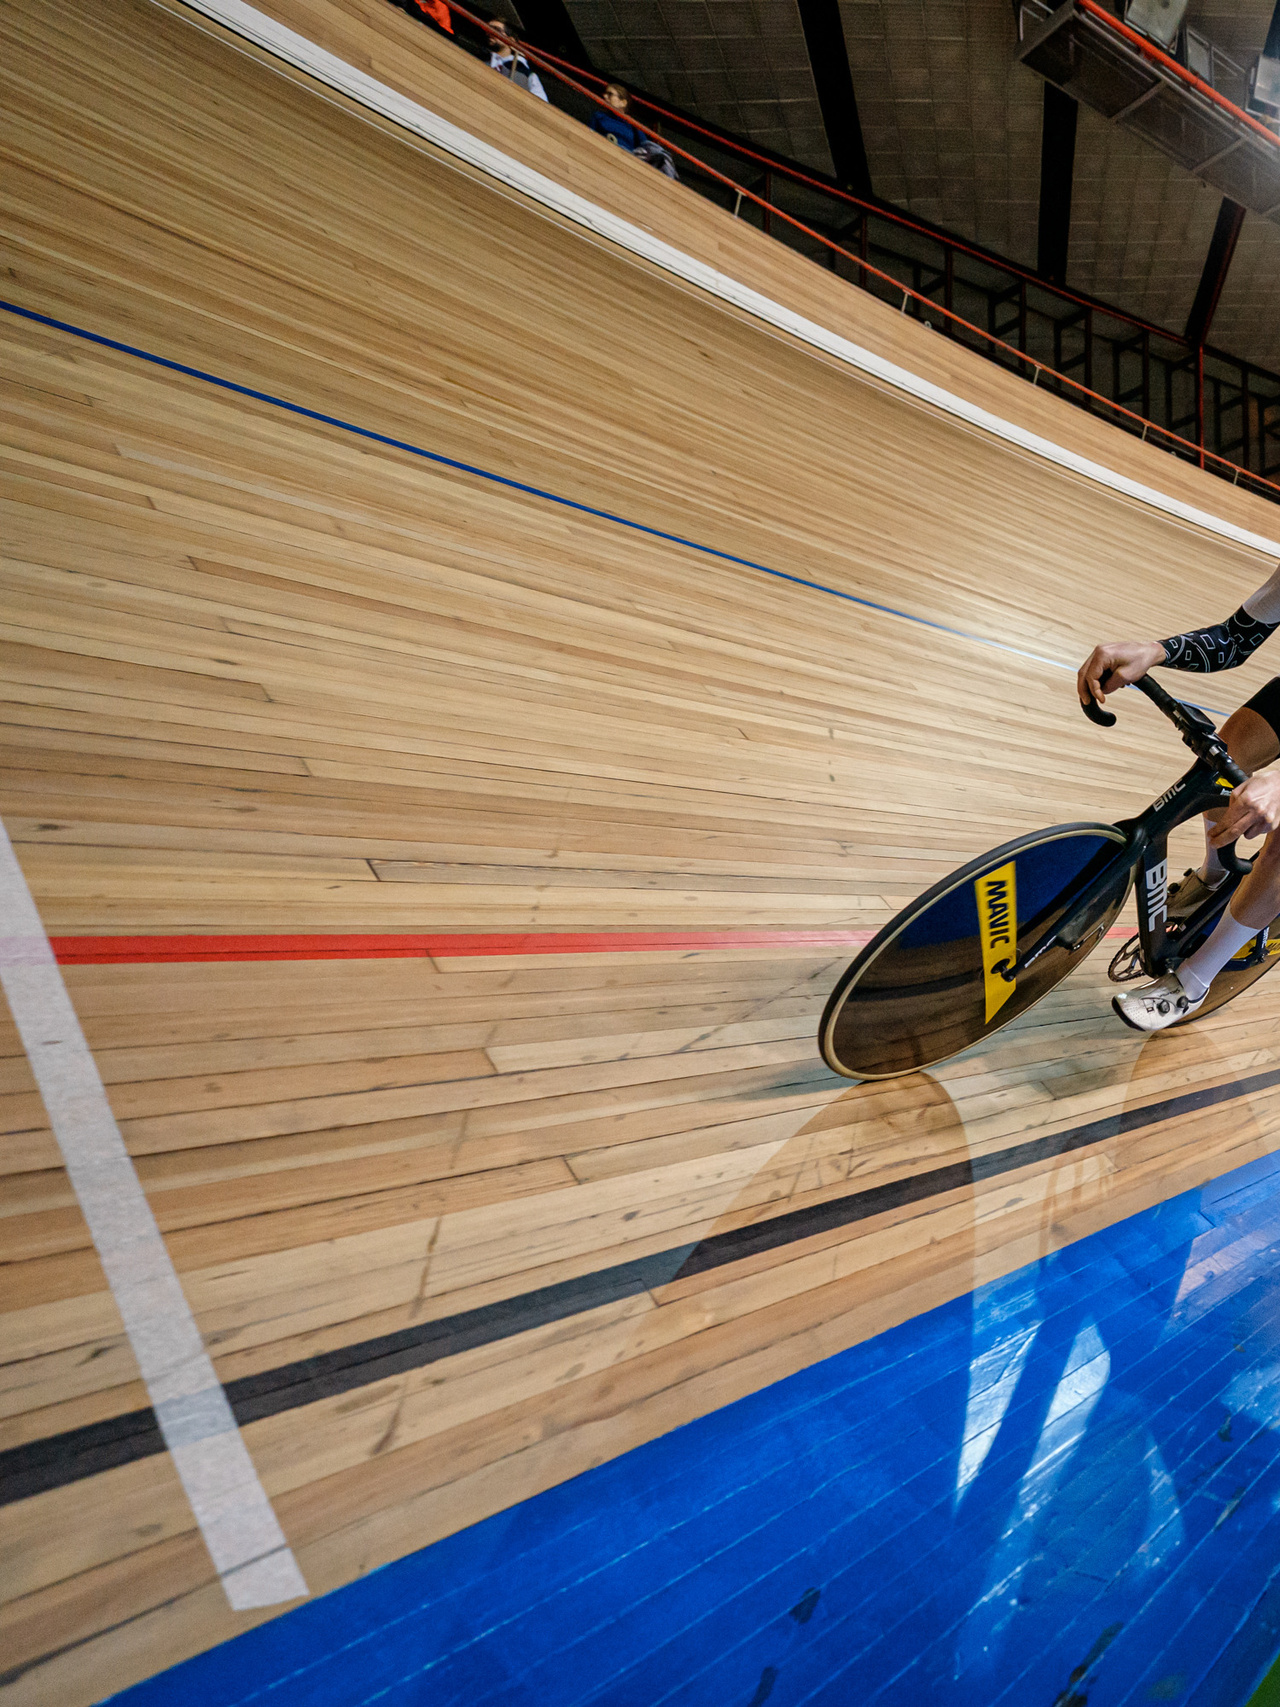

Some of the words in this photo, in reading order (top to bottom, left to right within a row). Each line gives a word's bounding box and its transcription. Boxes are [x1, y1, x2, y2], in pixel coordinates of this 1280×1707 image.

[1152, 778, 1186, 812] BMC
[986, 880, 1010, 949] MAVIC
[1146, 857, 1167, 932] BMC
